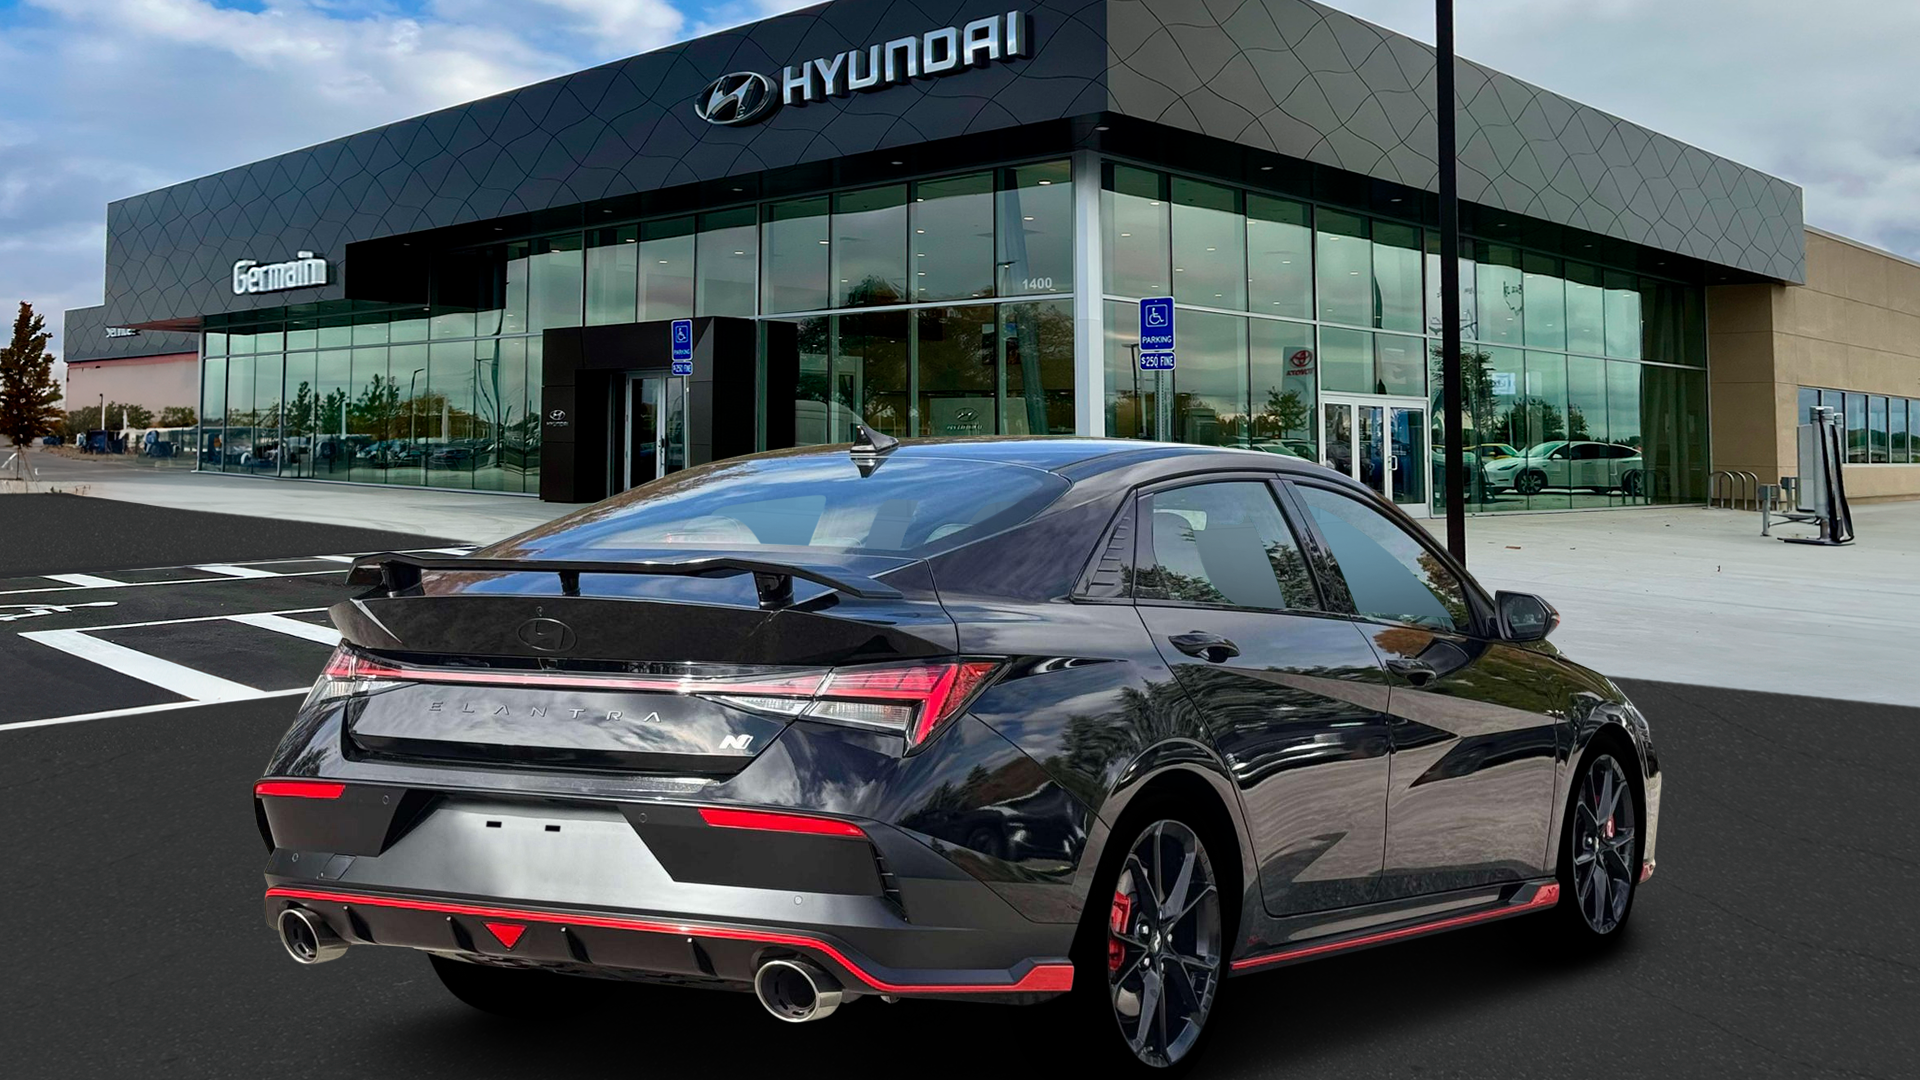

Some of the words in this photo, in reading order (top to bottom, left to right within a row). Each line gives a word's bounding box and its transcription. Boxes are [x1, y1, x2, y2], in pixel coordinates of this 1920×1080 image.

[782, 10, 1026, 105] HYUNDAI
[233, 250, 327, 295] Germain
[1022, 276, 1053, 290] 1400
[1142, 336, 1172, 344] PARKING
[1141, 356, 1159, 367] $250
[1160, 356, 1174, 367] FINE
[428, 701, 662, 723] ELANTRA
